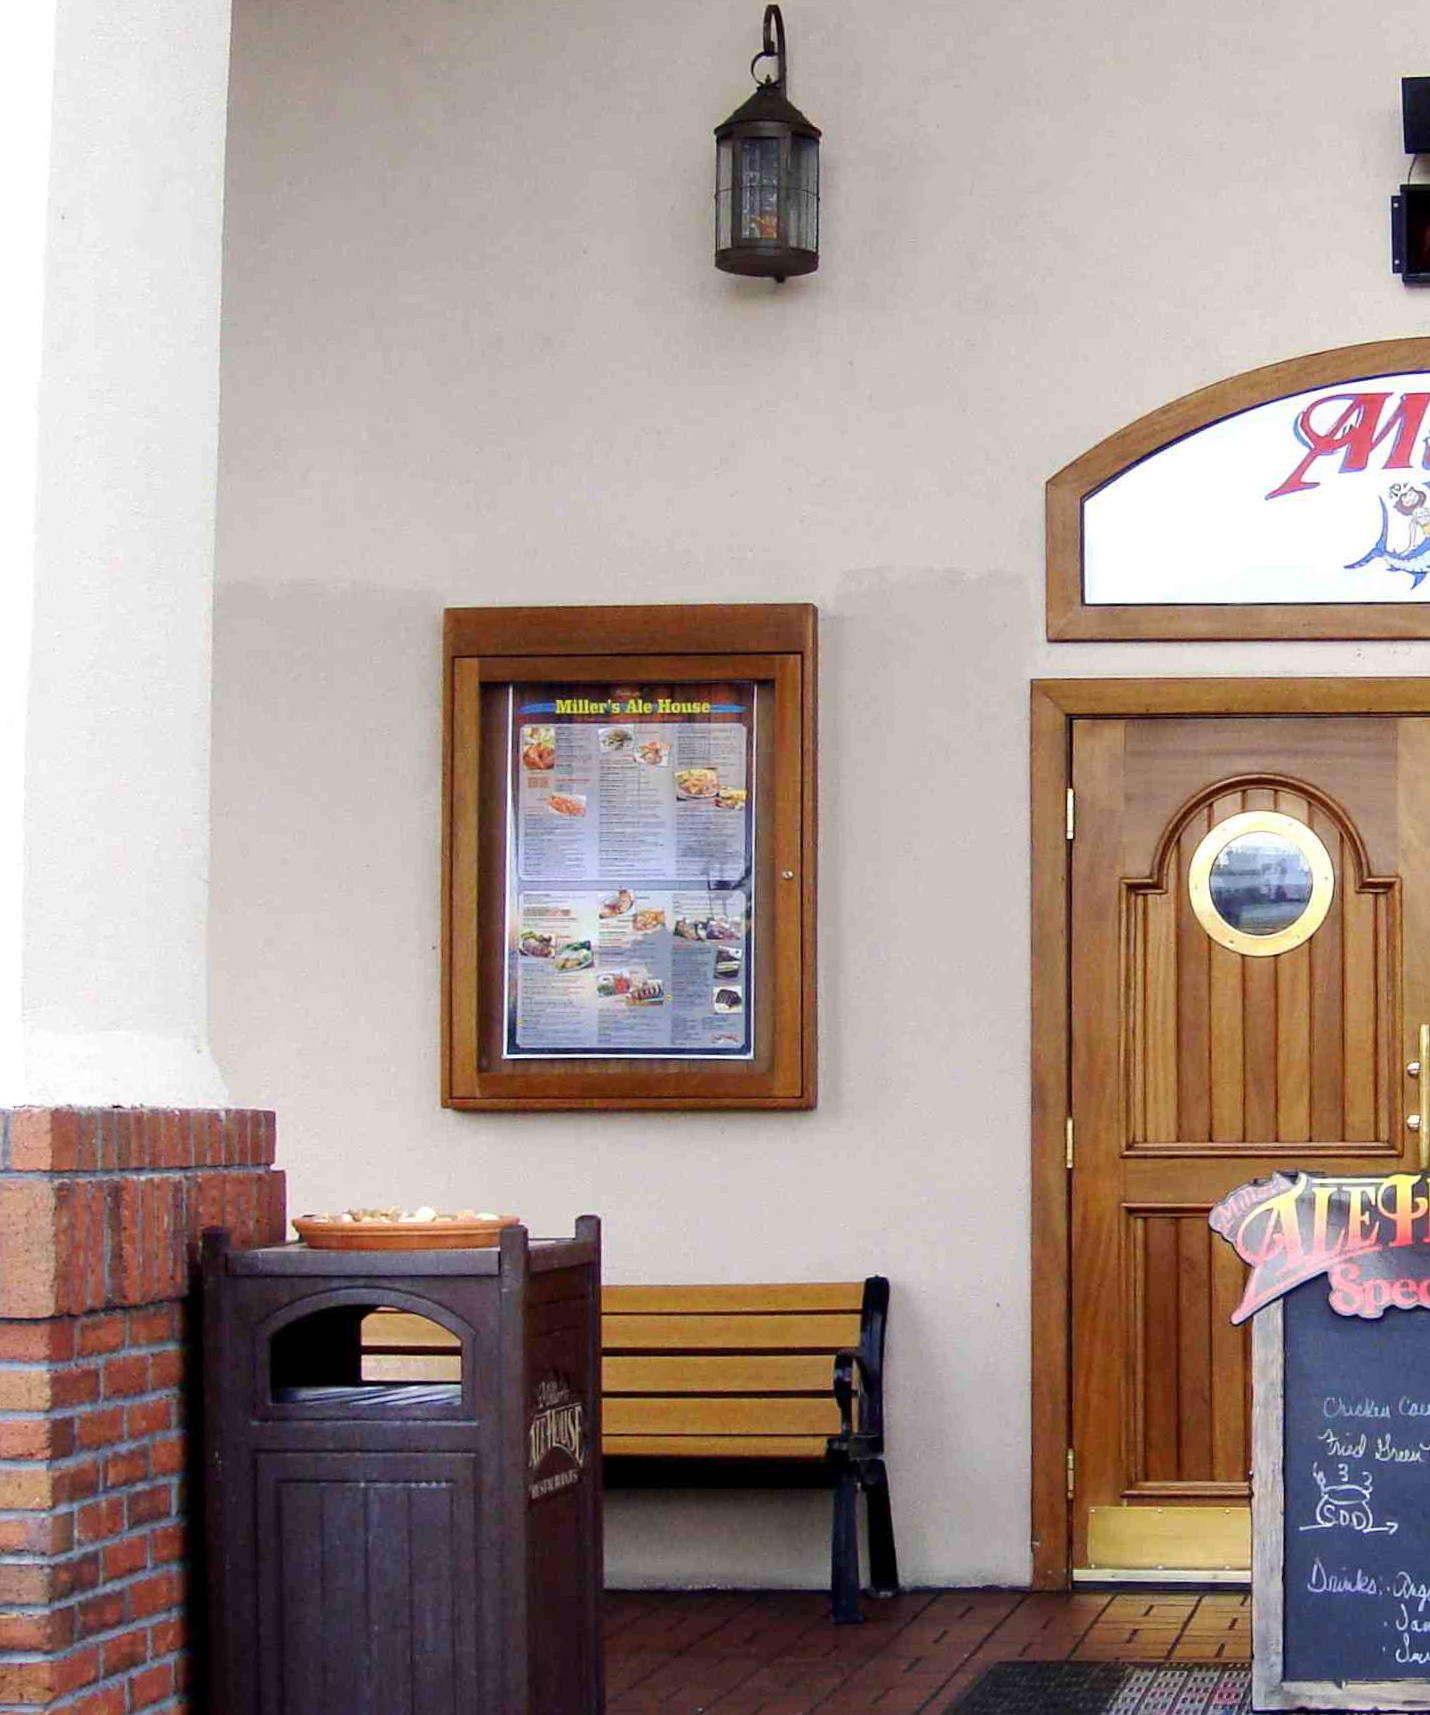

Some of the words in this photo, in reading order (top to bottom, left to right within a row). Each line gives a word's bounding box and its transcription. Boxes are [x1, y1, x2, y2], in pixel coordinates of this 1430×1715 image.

[555, 699, 621, 714] Miller's
[626, 699, 652, 714] Ale
[658, 699, 711, 714] House
[1317, 1428, 1367, 1456] Fried
[1375, 1433, 1423, 1462] Green
